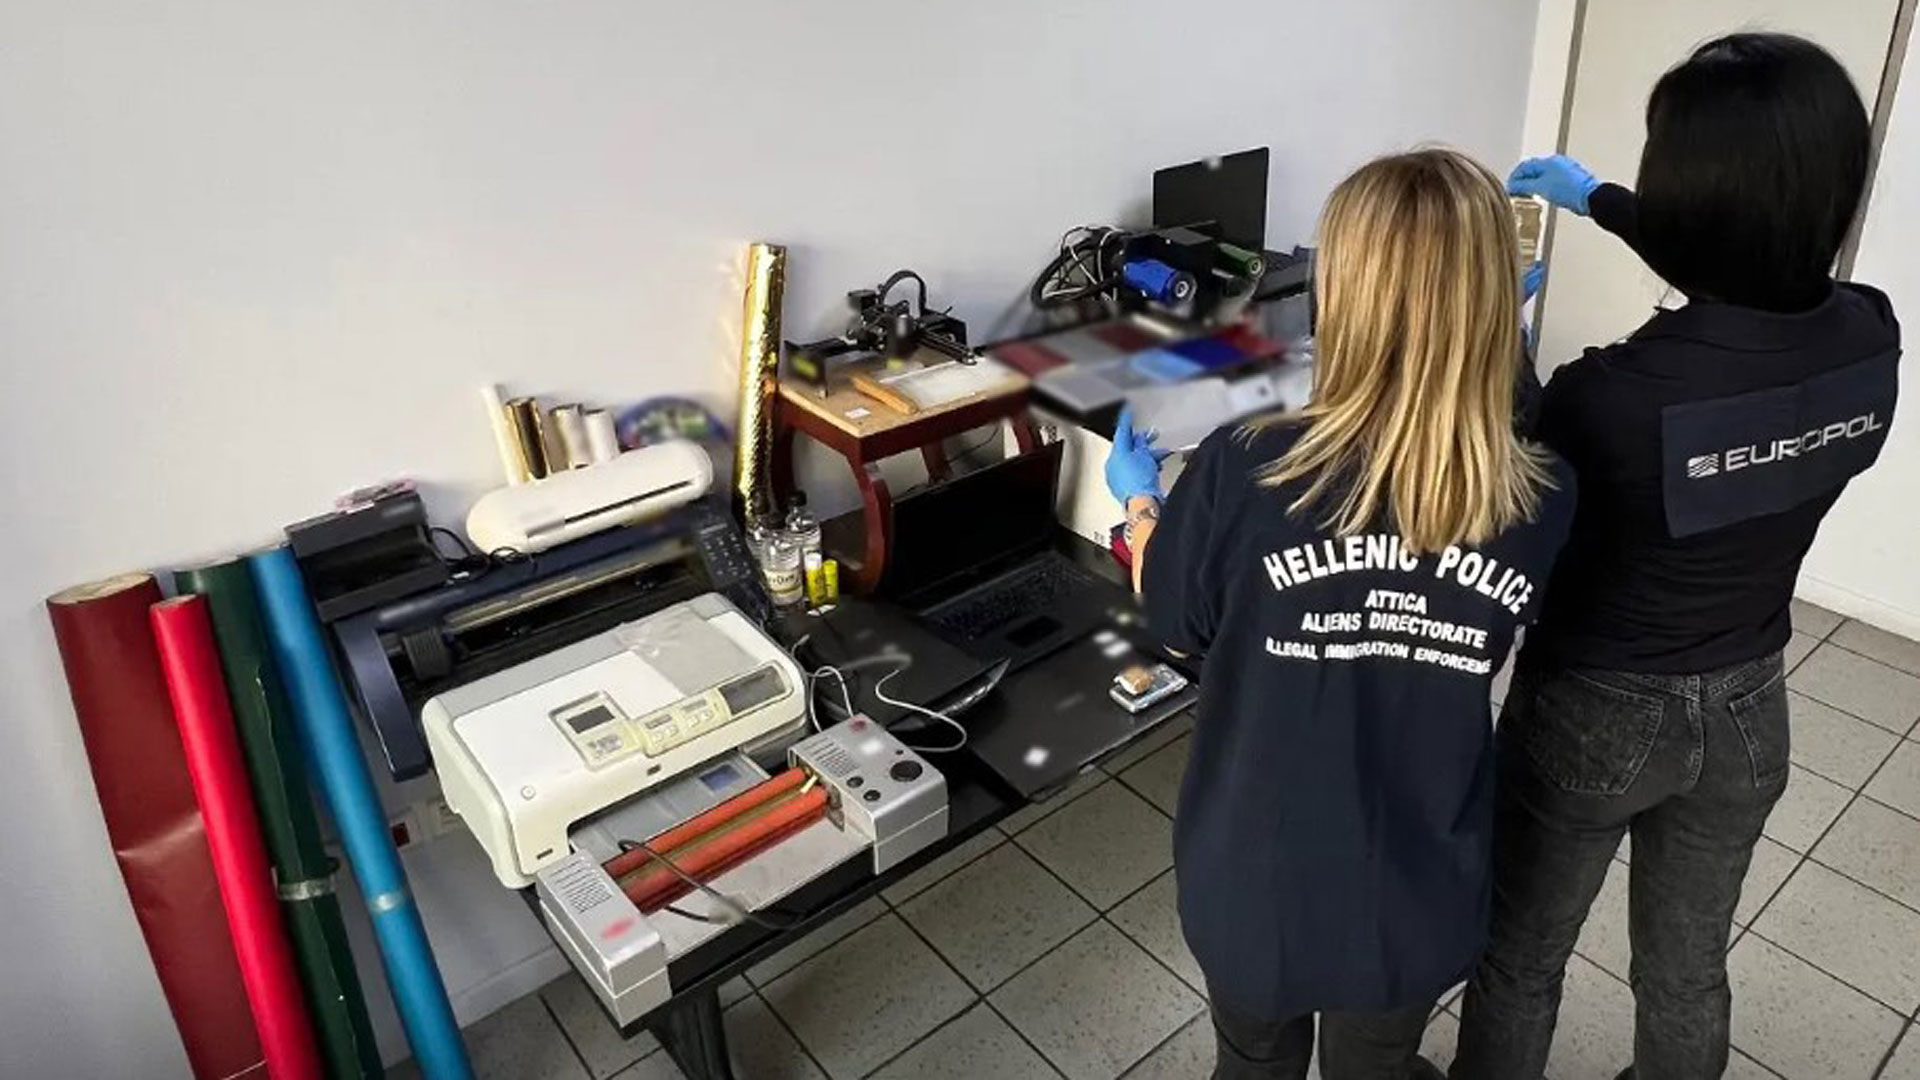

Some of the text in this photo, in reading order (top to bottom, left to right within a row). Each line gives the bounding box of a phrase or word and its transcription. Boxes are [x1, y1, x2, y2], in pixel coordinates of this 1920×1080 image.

[1725, 413, 1882, 471] EUROPOL
[1263, 534, 1534, 615] HELLENIC POLICE
[1365, 589, 1428, 614] ATTICA
[1266, 636, 1318, 660] ILLEGAL
[1325, 641, 1408, 659] IMMIGRATION
[1301, 612, 1488, 649] ALIENS DIRECTORATE
